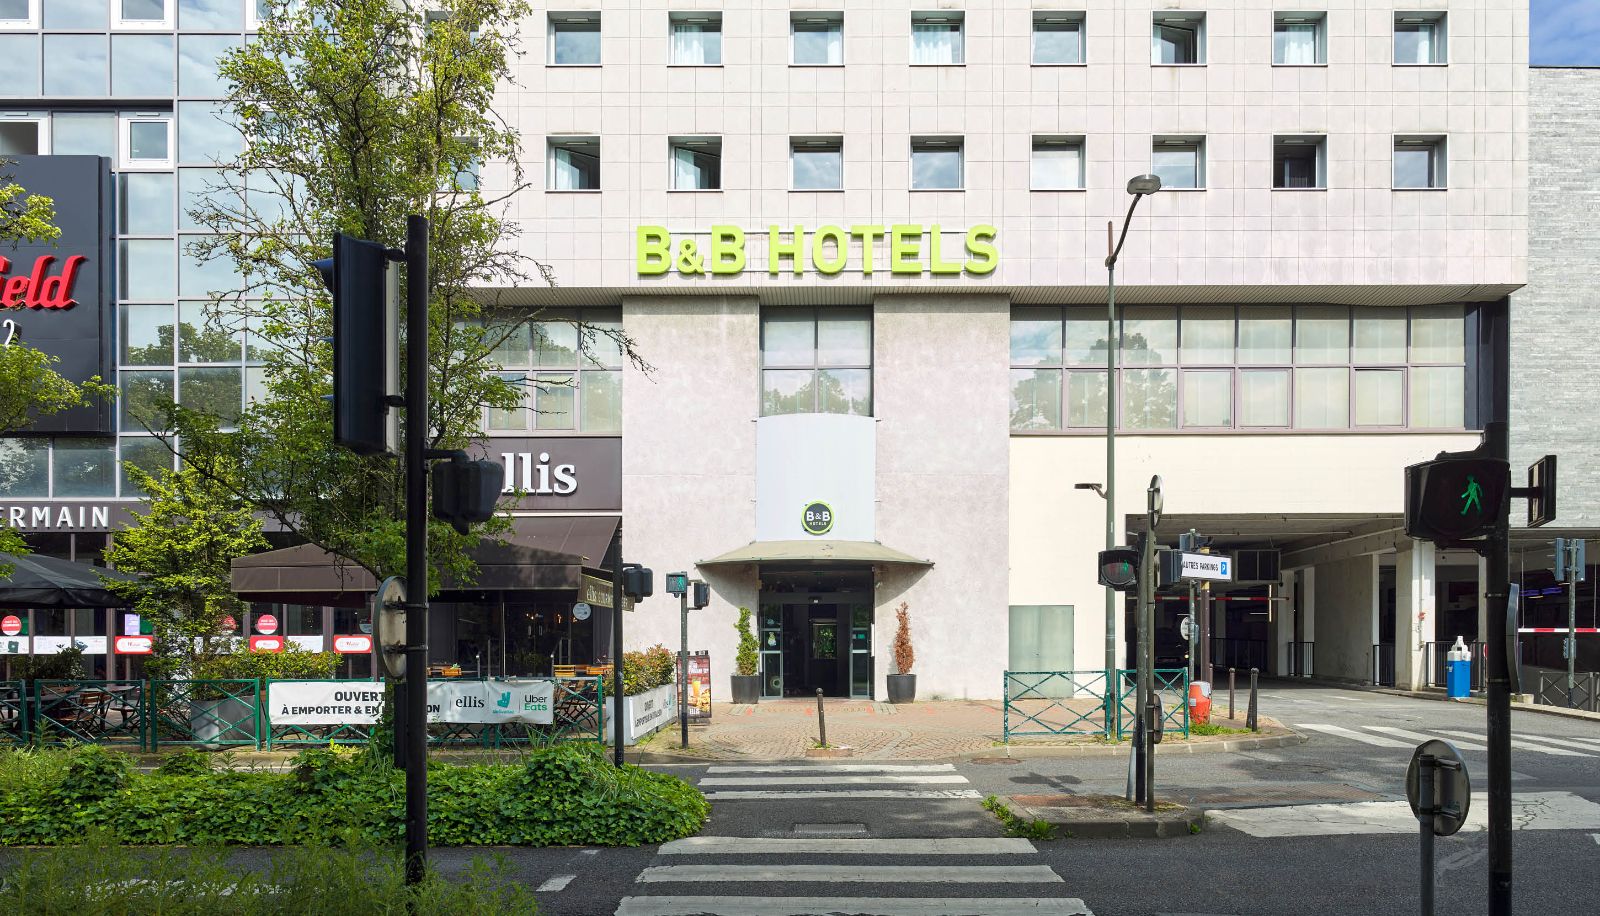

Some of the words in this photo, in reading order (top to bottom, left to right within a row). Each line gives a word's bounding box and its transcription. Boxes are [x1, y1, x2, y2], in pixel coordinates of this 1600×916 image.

[637, 224, 746, 275] B&B
[768, 224, 998, 275] HOTELS
[501, 452, 578, 494] llis
[806, 511, 830, 521] B&B
[455, 695, 485, 708] ellis
[524, 694, 548, 703] Uber
[281, 704, 290, 715] À
[291, 705, 352, 715] EMPORTER
[354, 705, 363, 715] &
[524, 702, 548, 711] Eats
